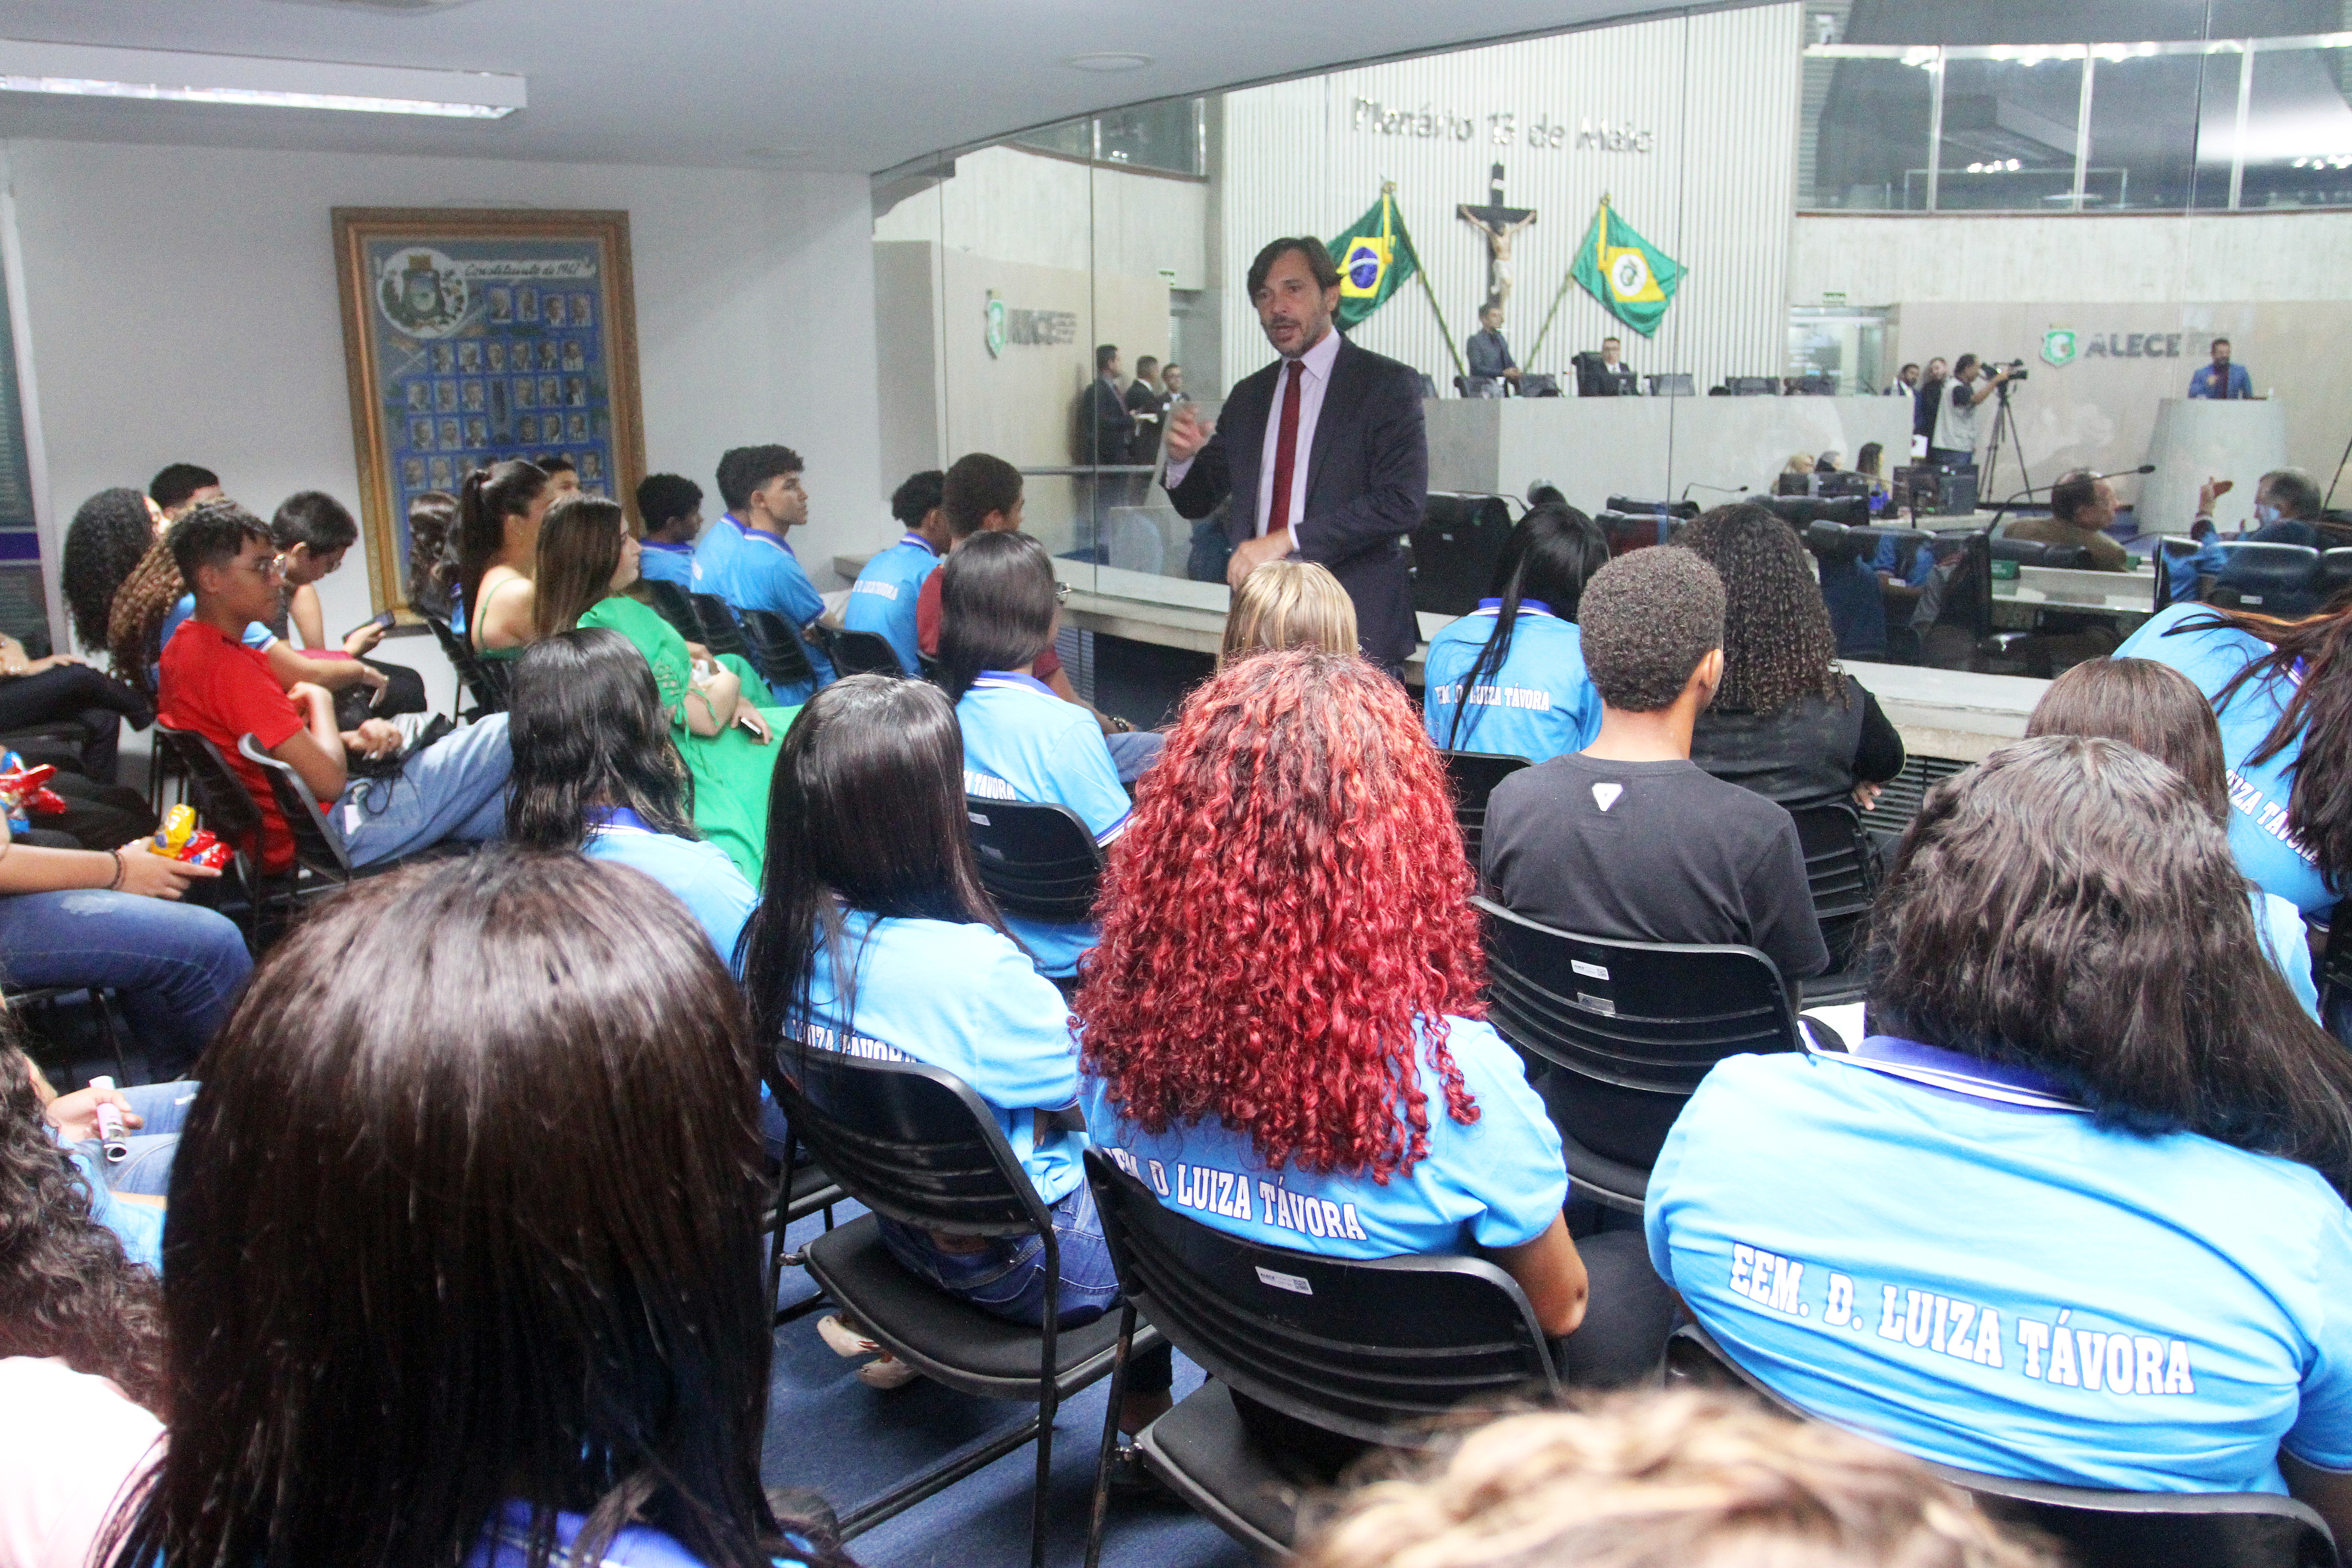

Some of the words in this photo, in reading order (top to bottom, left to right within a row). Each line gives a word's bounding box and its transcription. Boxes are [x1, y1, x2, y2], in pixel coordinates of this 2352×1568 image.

[1351, 95, 1474, 142] Plenário
[1529, 113, 1565, 148] de
[1576, 117, 1654, 153] Maio
[2085, 333, 2181, 358] ALECE
[1469, 686, 1501, 706] LUIZA
[1504, 682, 1549, 711] TÁVORA
[1177, 1164, 1251, 1220] LUIZA
[1259, 1176, 1367, 1240] TÁVORA
[1730, 1243, 1810, 1317] EEM.
[1823, 1272, 1862, 1330] D.
[1877, 1284, 2003, 1367] LUIZA
[2018, 1309, 2195, 1394] TÁVORA
